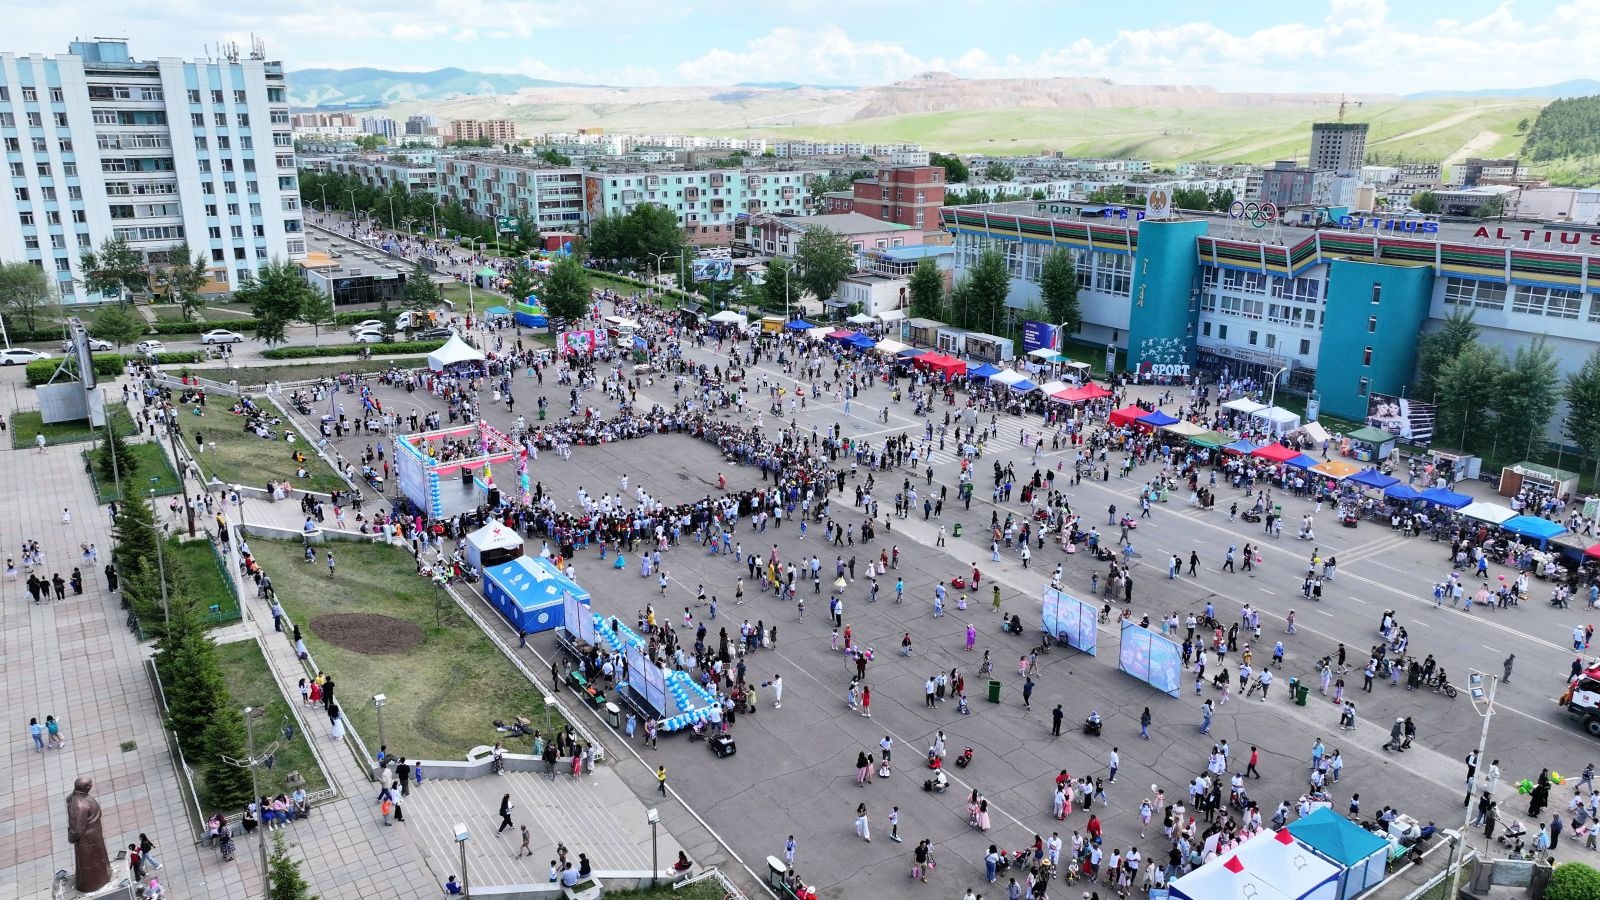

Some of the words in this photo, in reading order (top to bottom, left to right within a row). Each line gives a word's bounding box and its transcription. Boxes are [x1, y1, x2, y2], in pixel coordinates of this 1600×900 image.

[1338, 215, 1440, 233] CITIUS
[1133, 362, 1141, 375] I
[1152, 363, 1191, 376] SPORT
